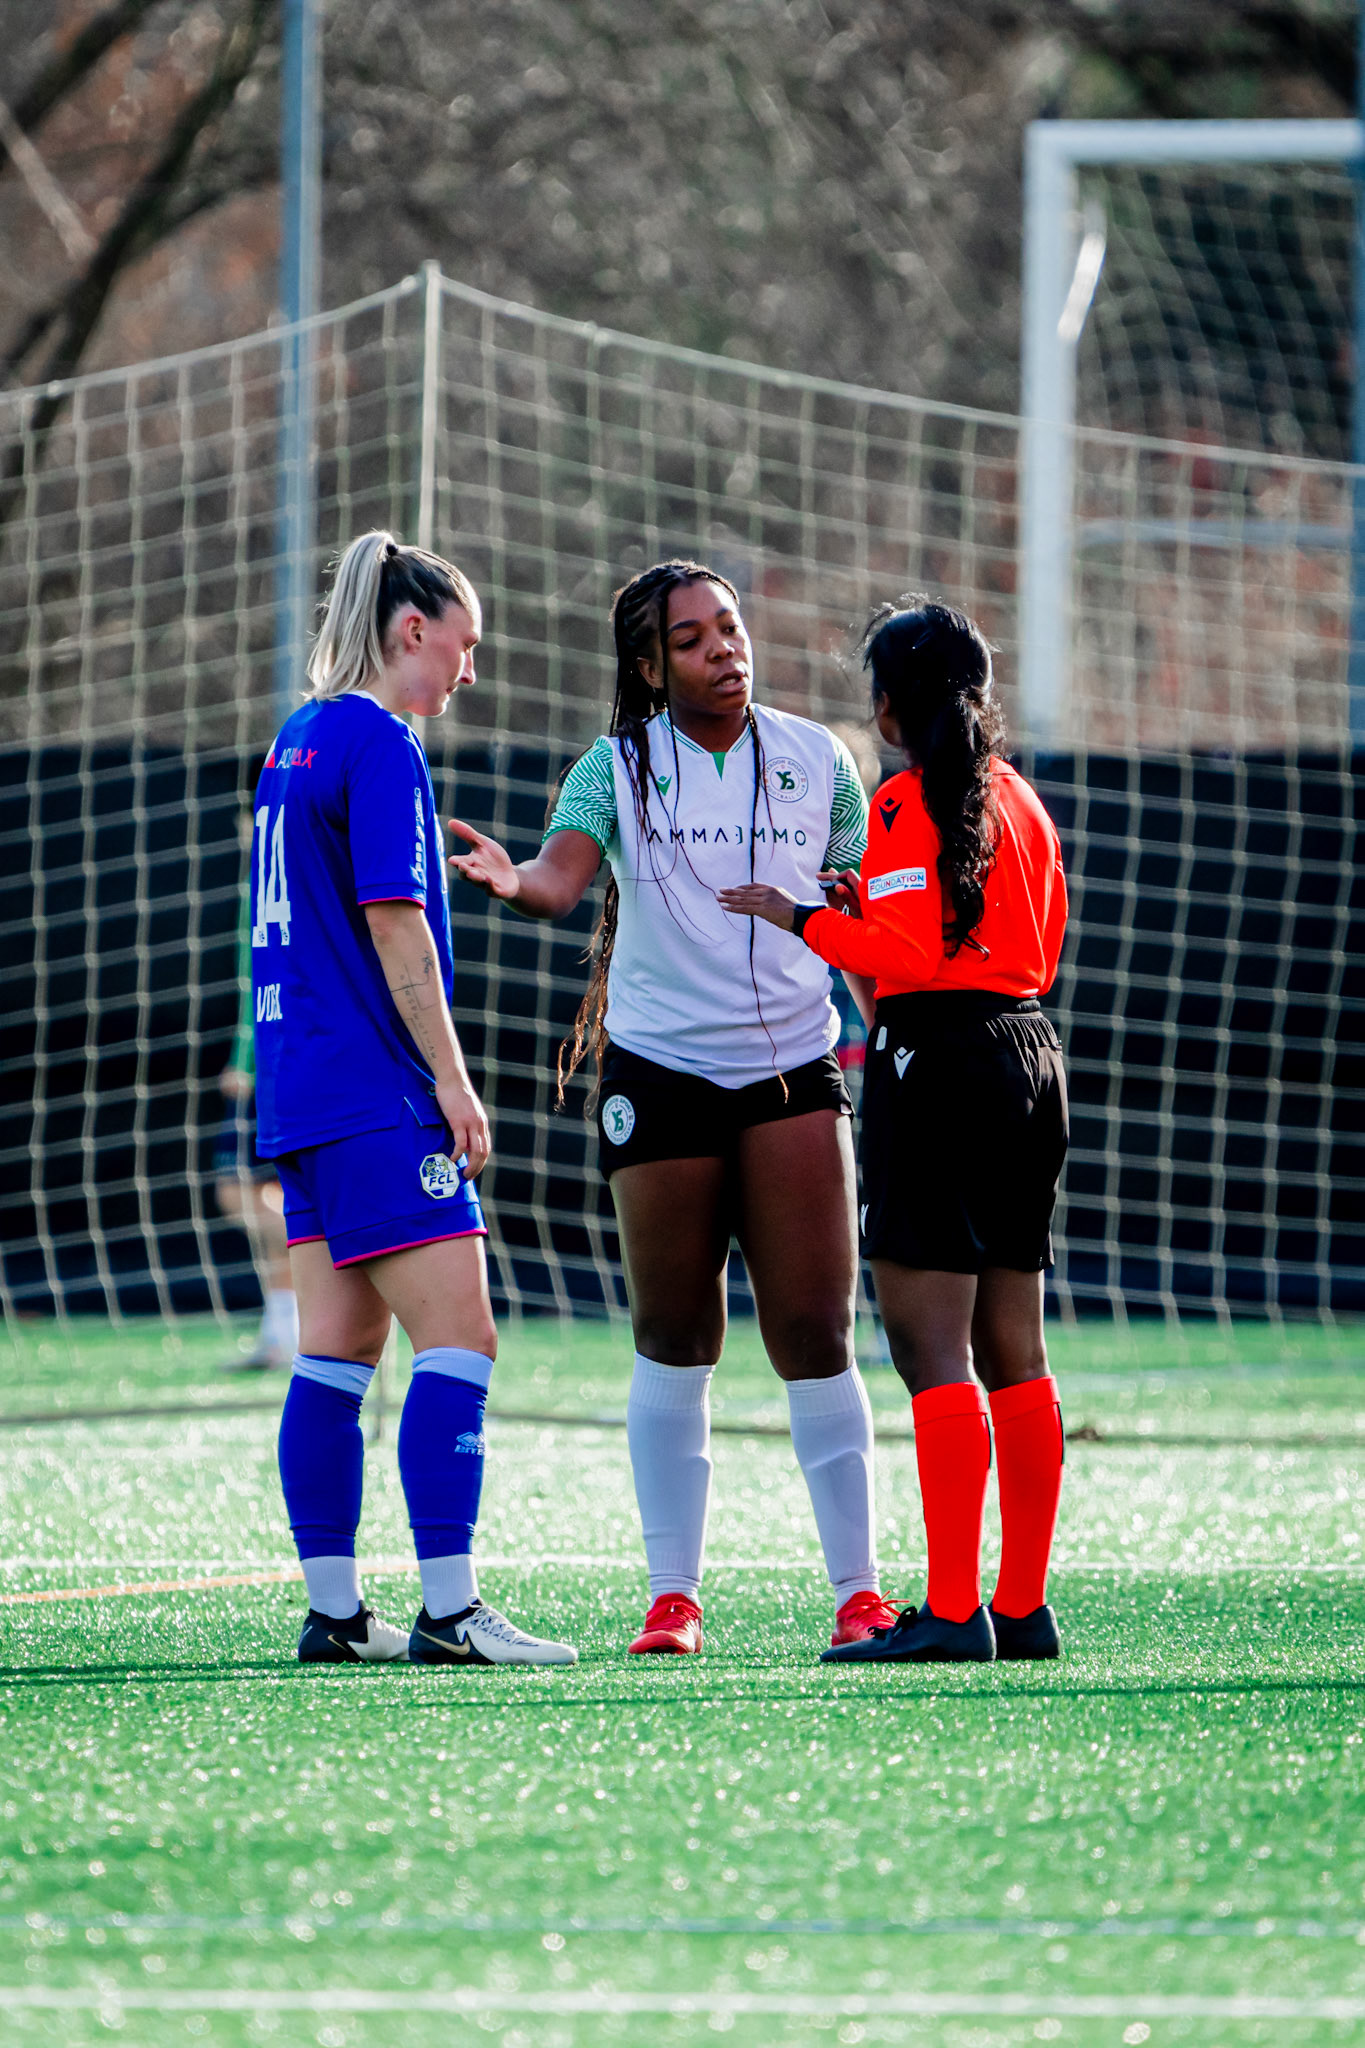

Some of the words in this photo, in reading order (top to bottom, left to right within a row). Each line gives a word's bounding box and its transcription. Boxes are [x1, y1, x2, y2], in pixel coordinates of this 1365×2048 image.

[251, 804, 292, 948] 14
[869, 874, 925, 893] FOUNDATION
[428, 1173, 454, 1187] FCL
